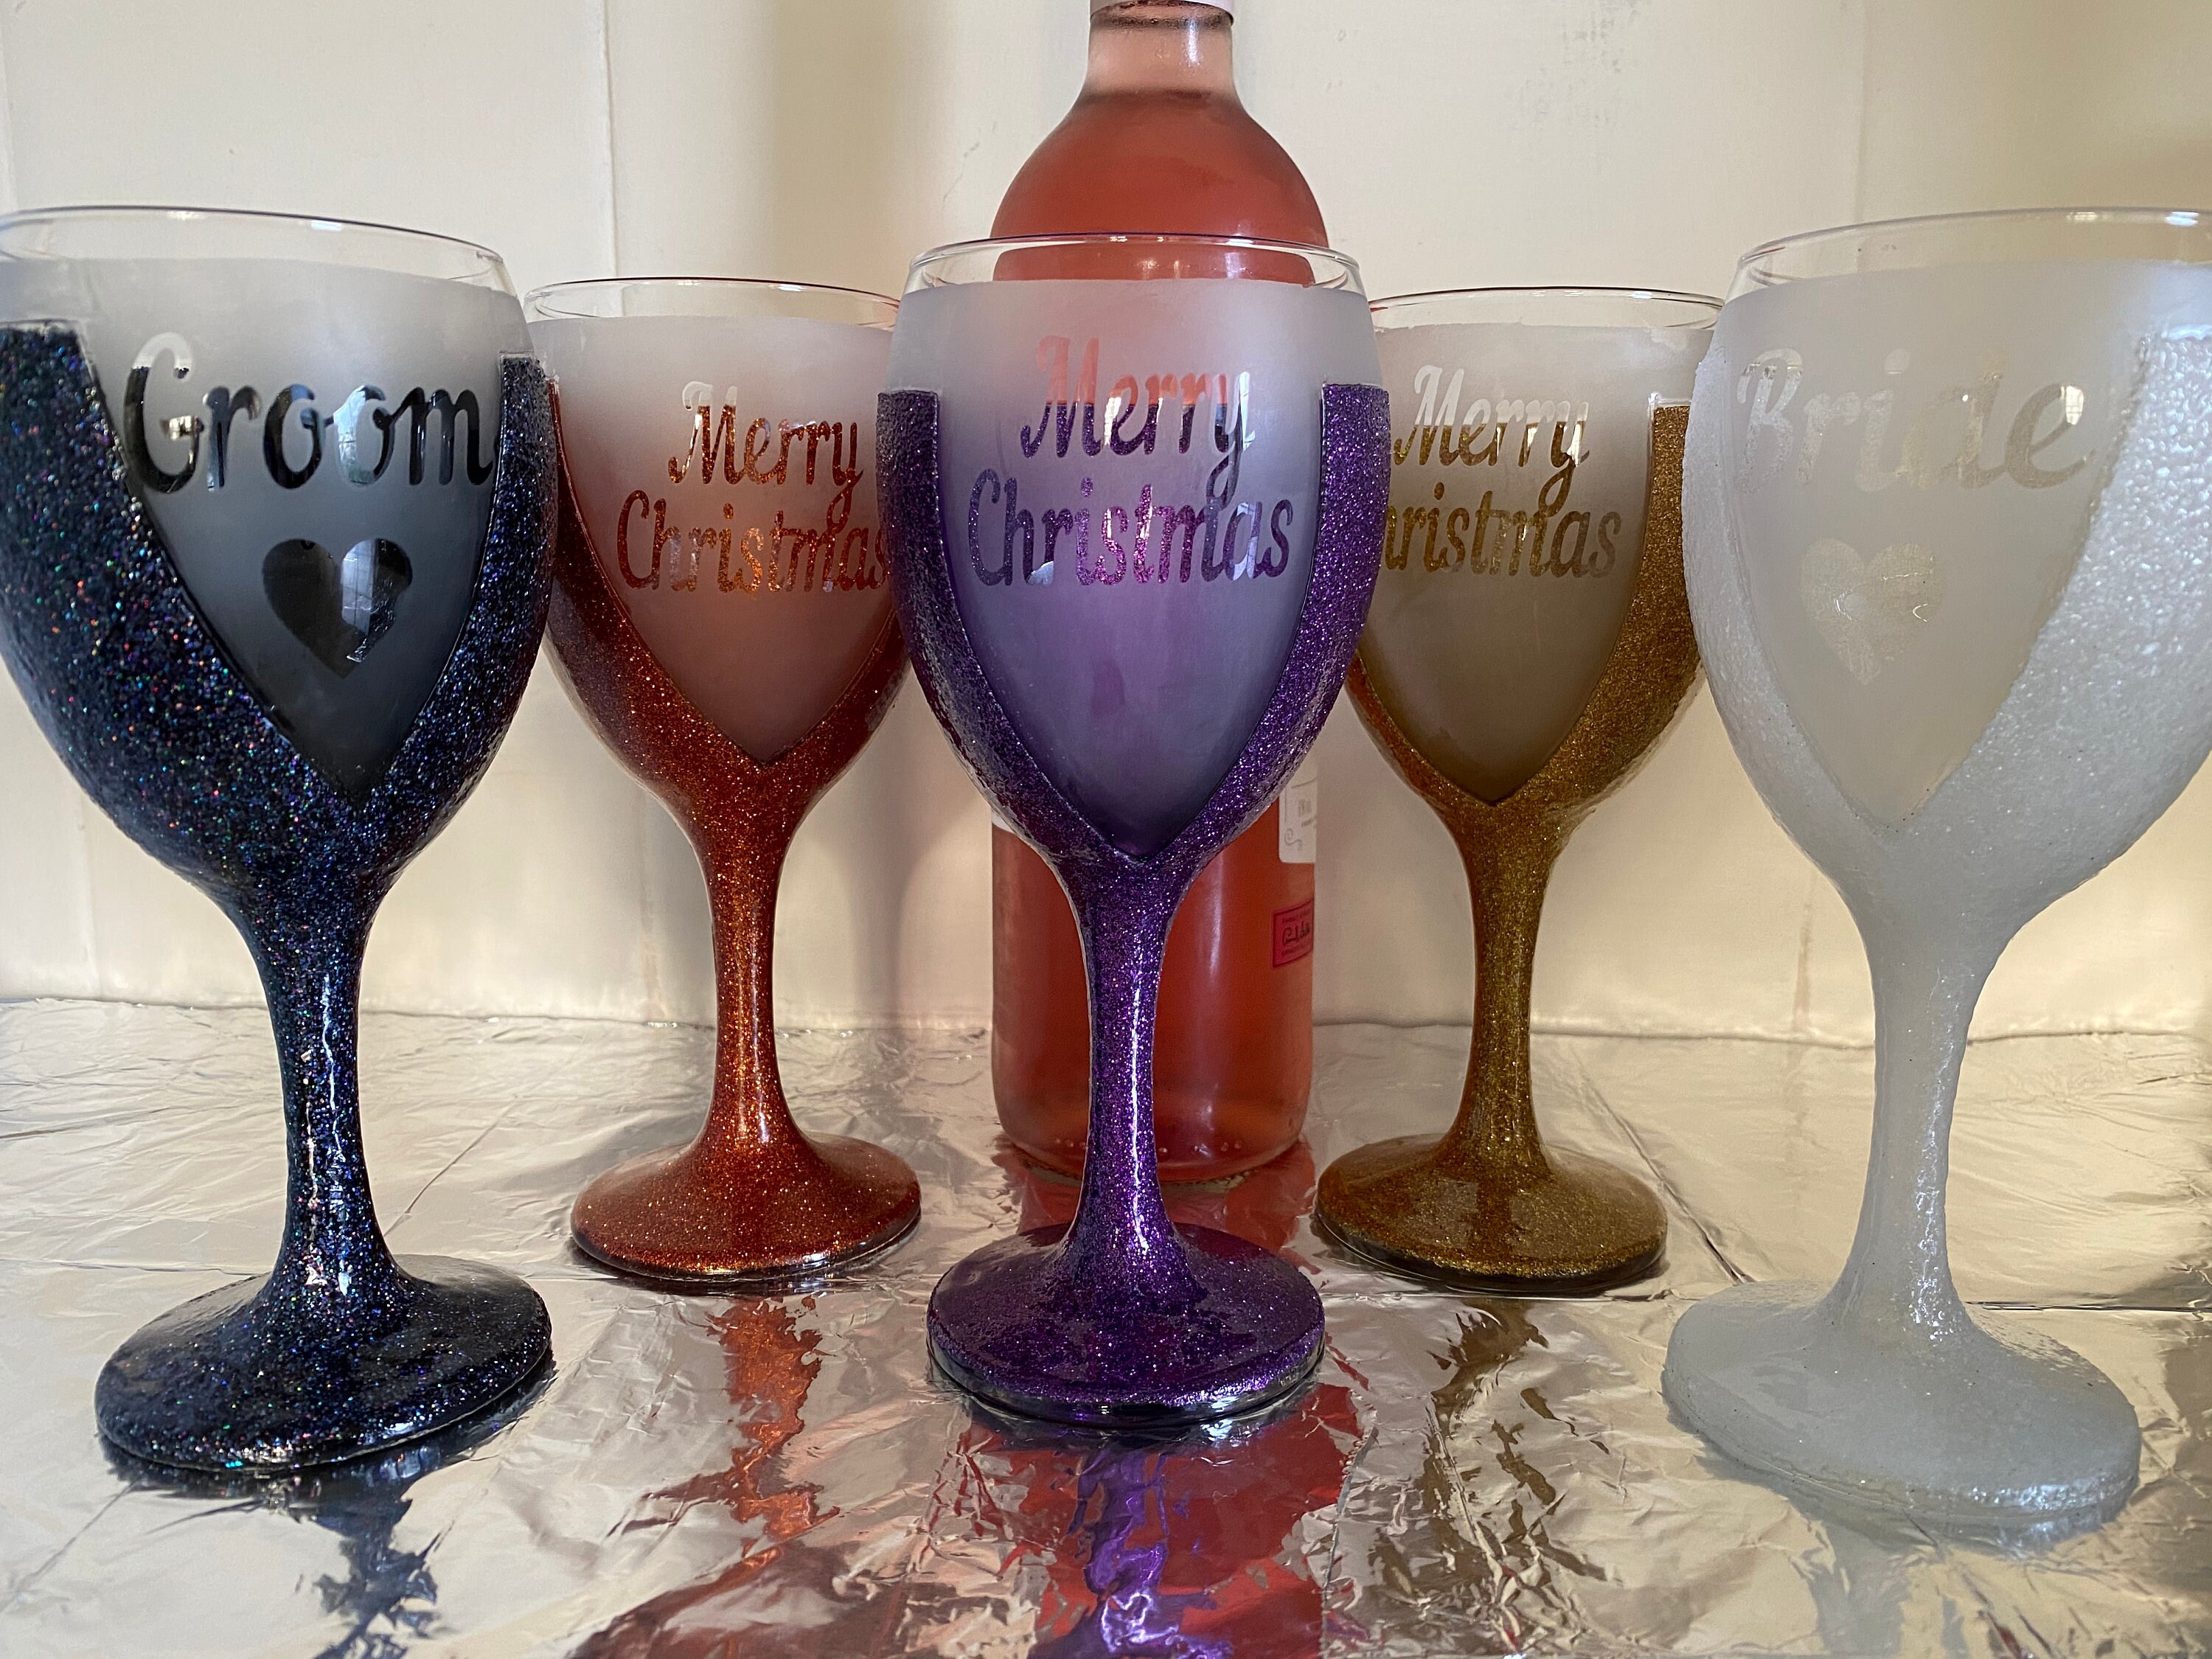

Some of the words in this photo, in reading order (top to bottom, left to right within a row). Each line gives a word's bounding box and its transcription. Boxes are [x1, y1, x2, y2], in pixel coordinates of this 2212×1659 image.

[123, 332, 495, 494] Groom
[668, 380, 863, 535] Merry
[1020, 335, 1255, 510] Merry
[1393, 364, 1590, 516] Merry
[1734, 347, 2096, 493] Bride
[968, 468, 1293, 586] Christmas
[1385, 481, 1621, 578] ristmas
